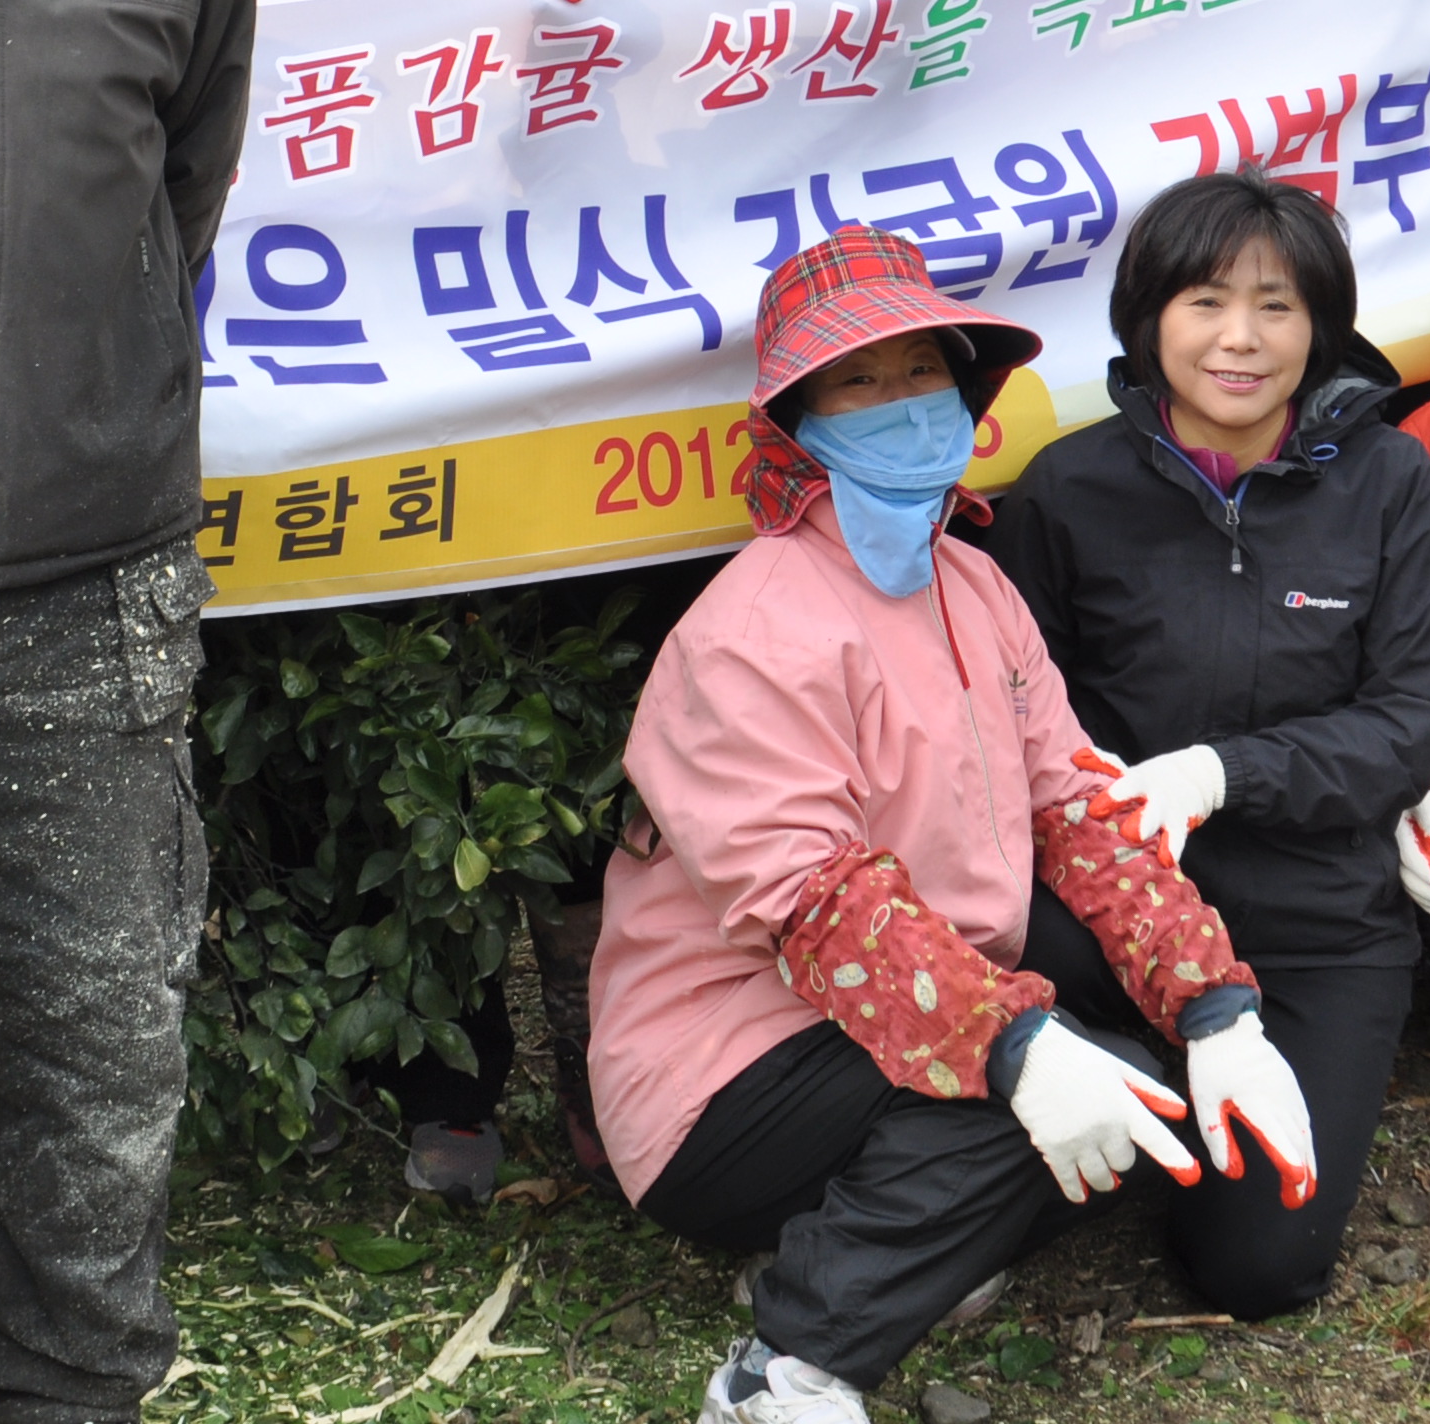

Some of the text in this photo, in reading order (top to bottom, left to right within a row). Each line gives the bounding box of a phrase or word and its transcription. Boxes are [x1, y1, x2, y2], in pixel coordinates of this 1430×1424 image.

[226, 23, 624, 180] 품감귤
[201, 223, 389, 387] 은
[412, 194, 723, 372] 밀식
